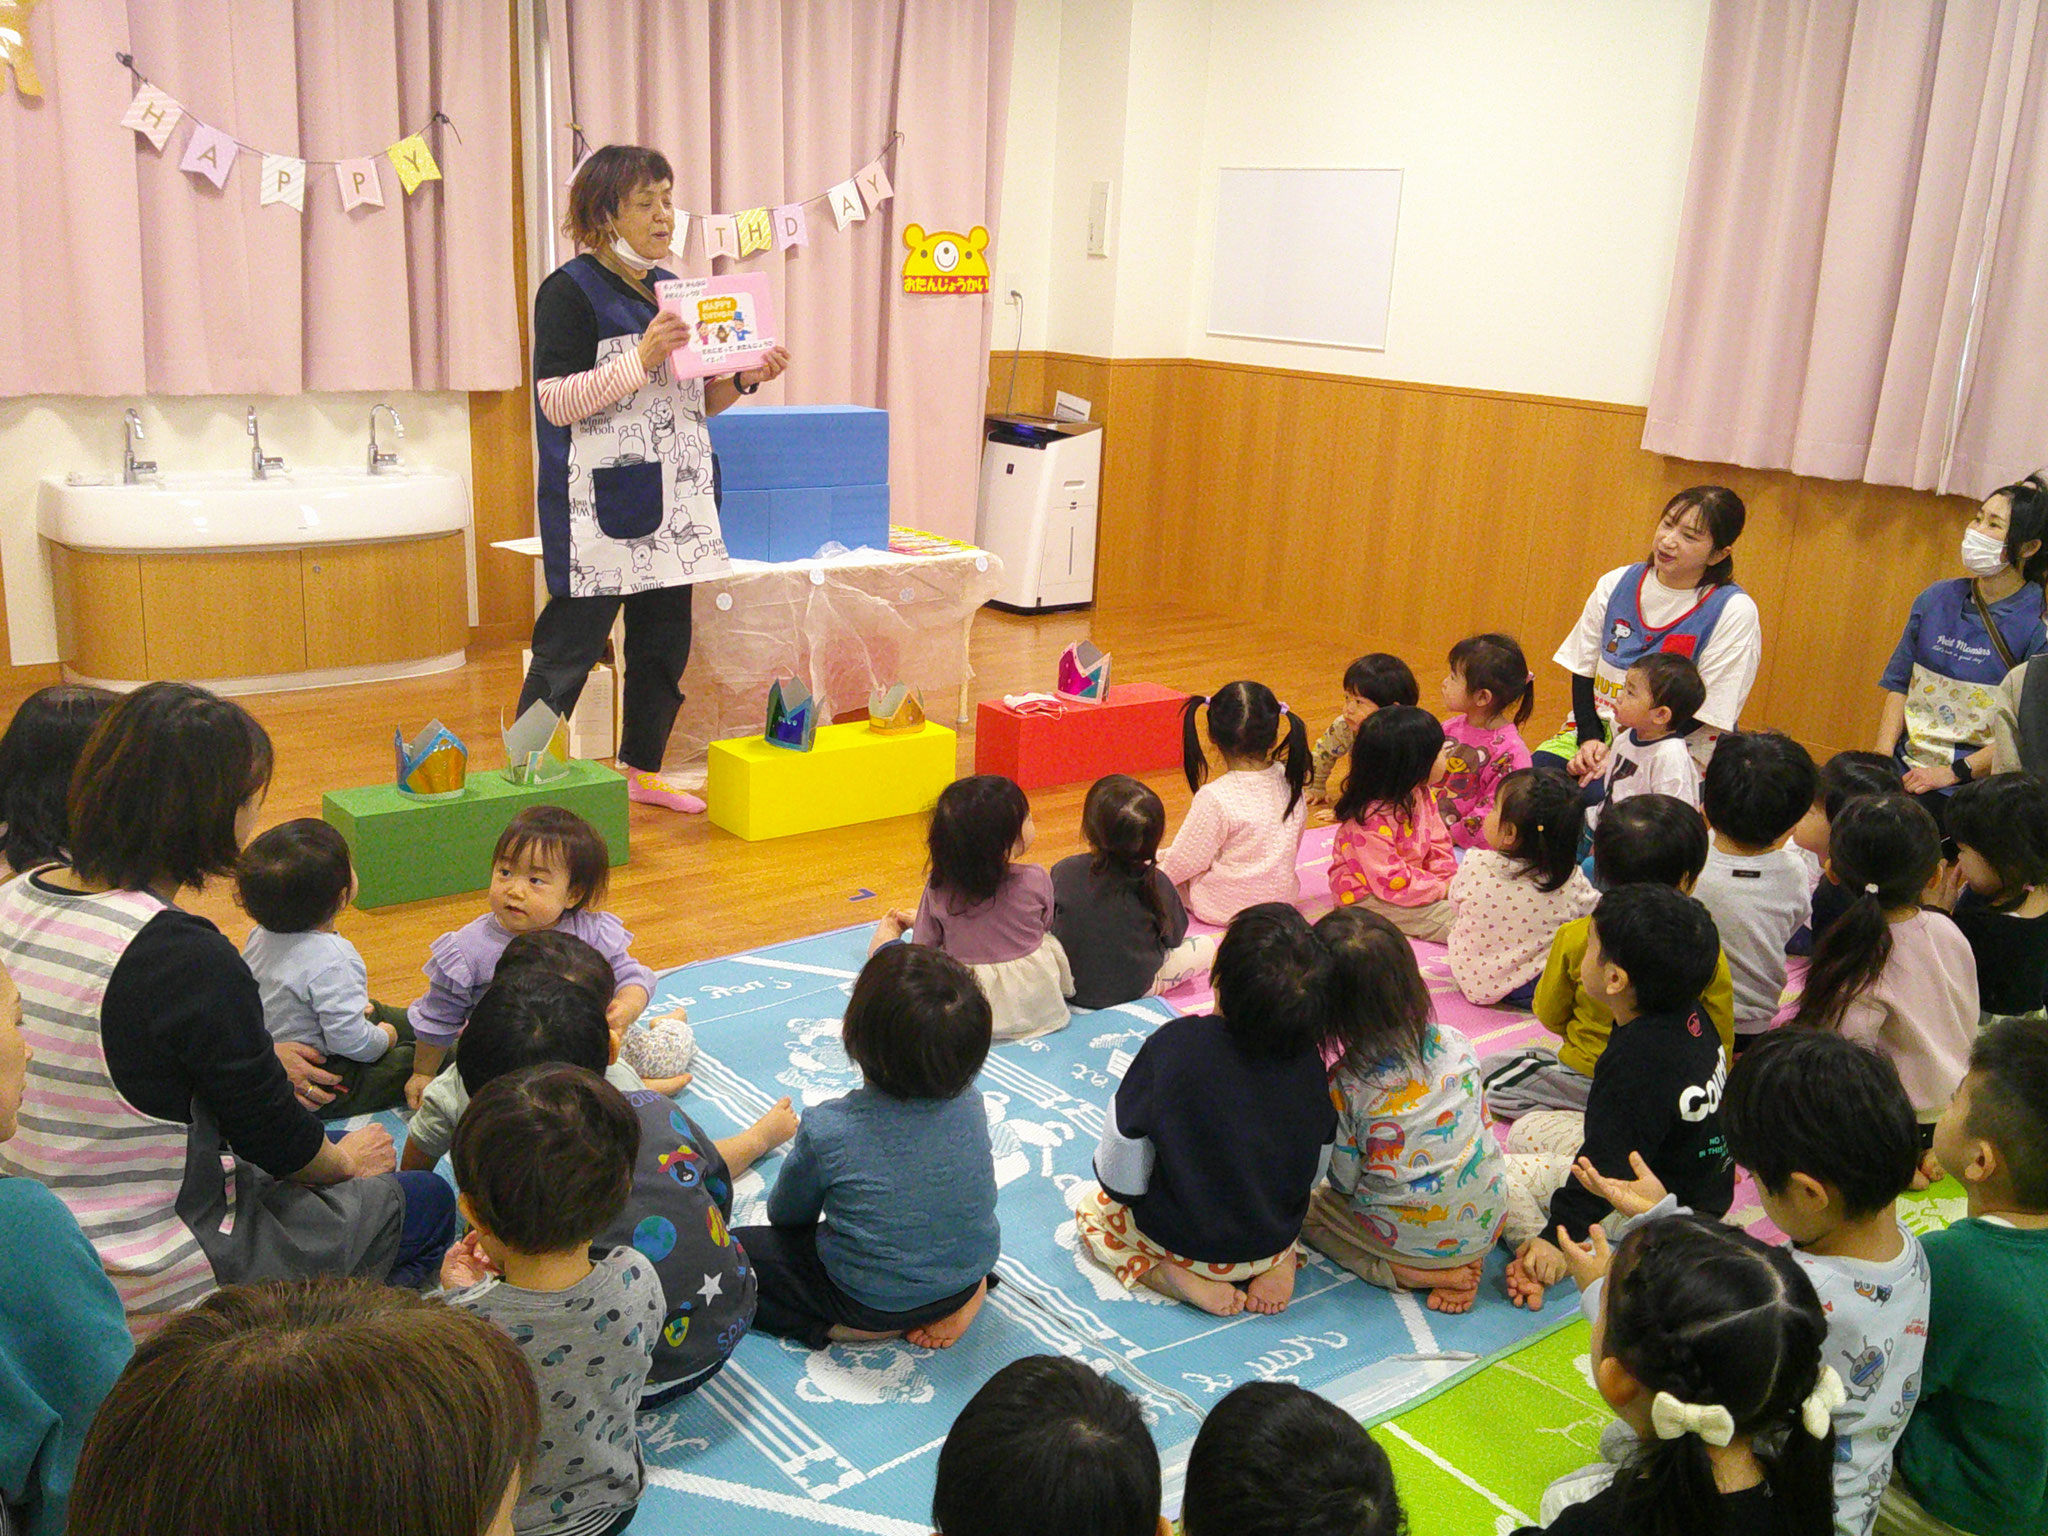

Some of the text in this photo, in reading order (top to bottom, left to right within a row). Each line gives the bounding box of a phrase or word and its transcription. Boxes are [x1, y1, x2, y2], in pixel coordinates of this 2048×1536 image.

[141, 101, 421, 195] HAPPY
[715, 173, 880, 248] THDAY
[903, 276, 990, 293] おたんじょうかい
